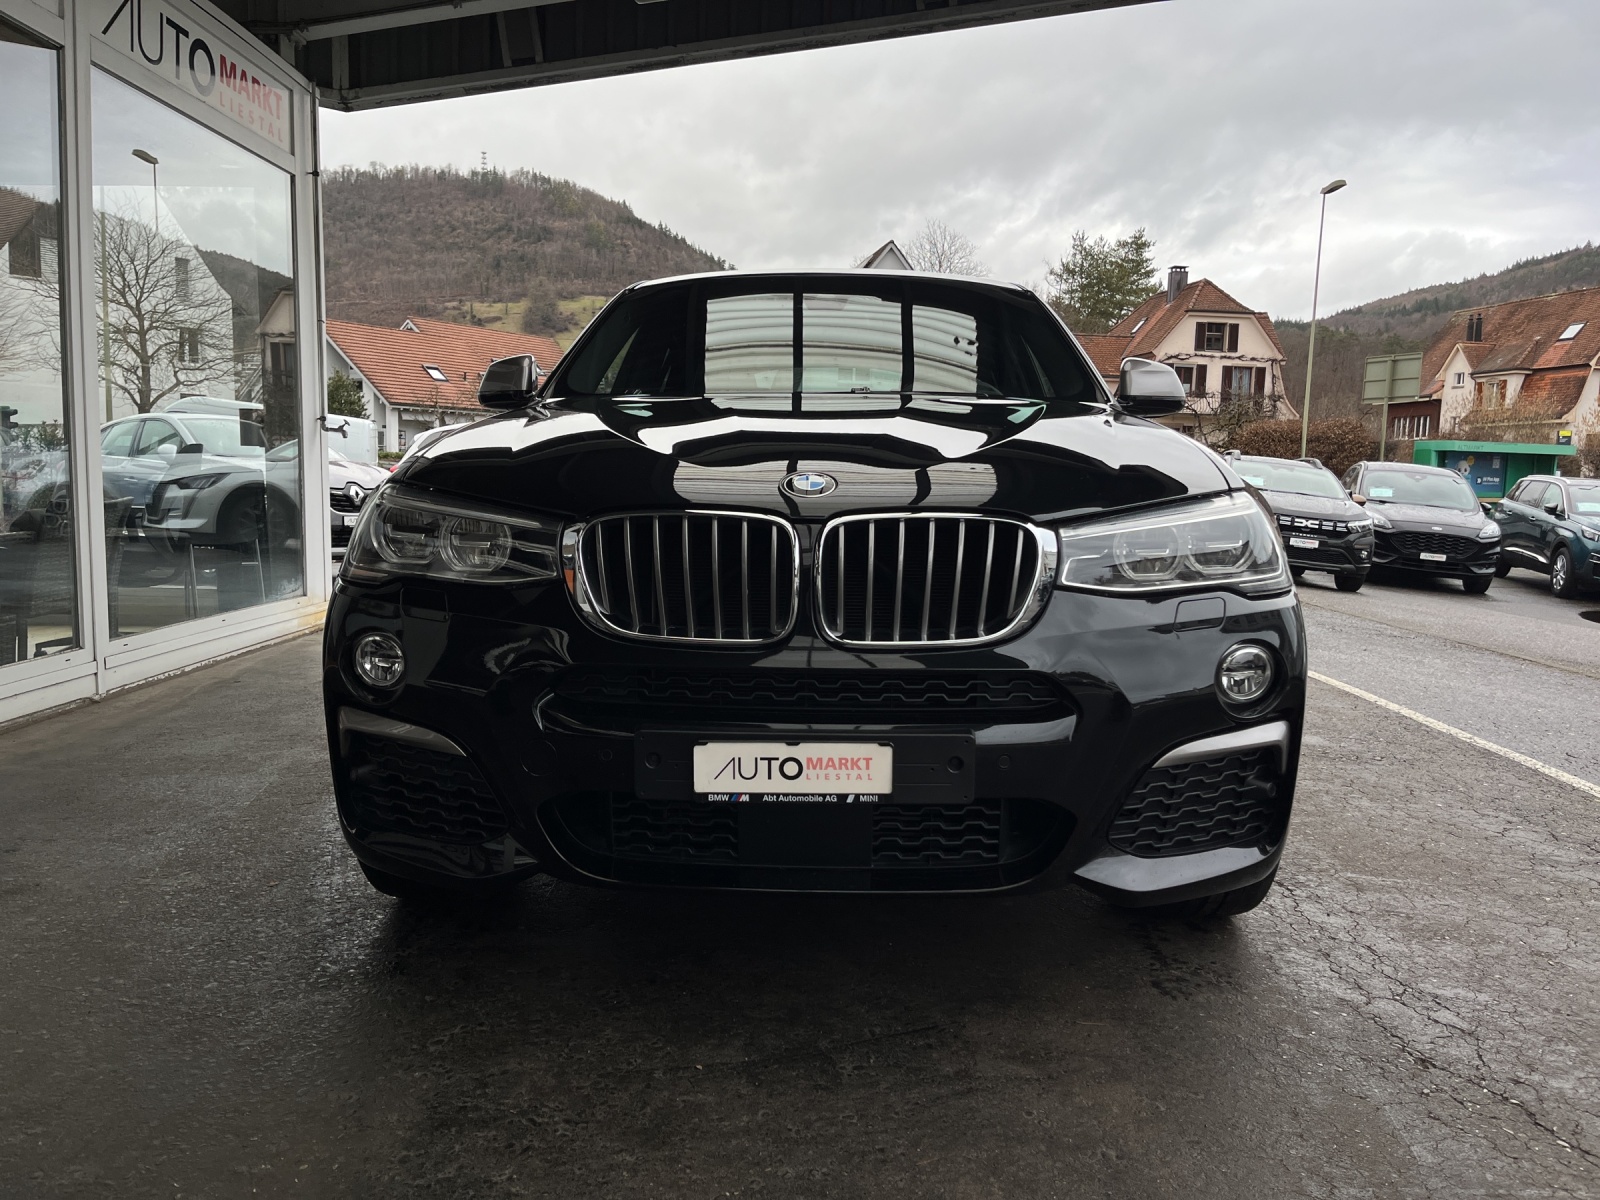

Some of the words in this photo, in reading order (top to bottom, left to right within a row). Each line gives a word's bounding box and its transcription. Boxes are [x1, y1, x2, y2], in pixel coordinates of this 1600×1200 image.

[219, 54, 283, 120] MARKT
[219, 91, 284, 143] LIESTAL
[713, 756, 804, 781] AUTO
[806, 757, 873, 770] MARKT
[805, 773, 873, 781] LIESTAL
[708, 793, 730, 802] BMW
[762, 794, 777, 802] Abt
[778, 794, 824, 803] Automobile
[824, 794, 838, 802] AG
[859, 794, 879, 803] MINI
